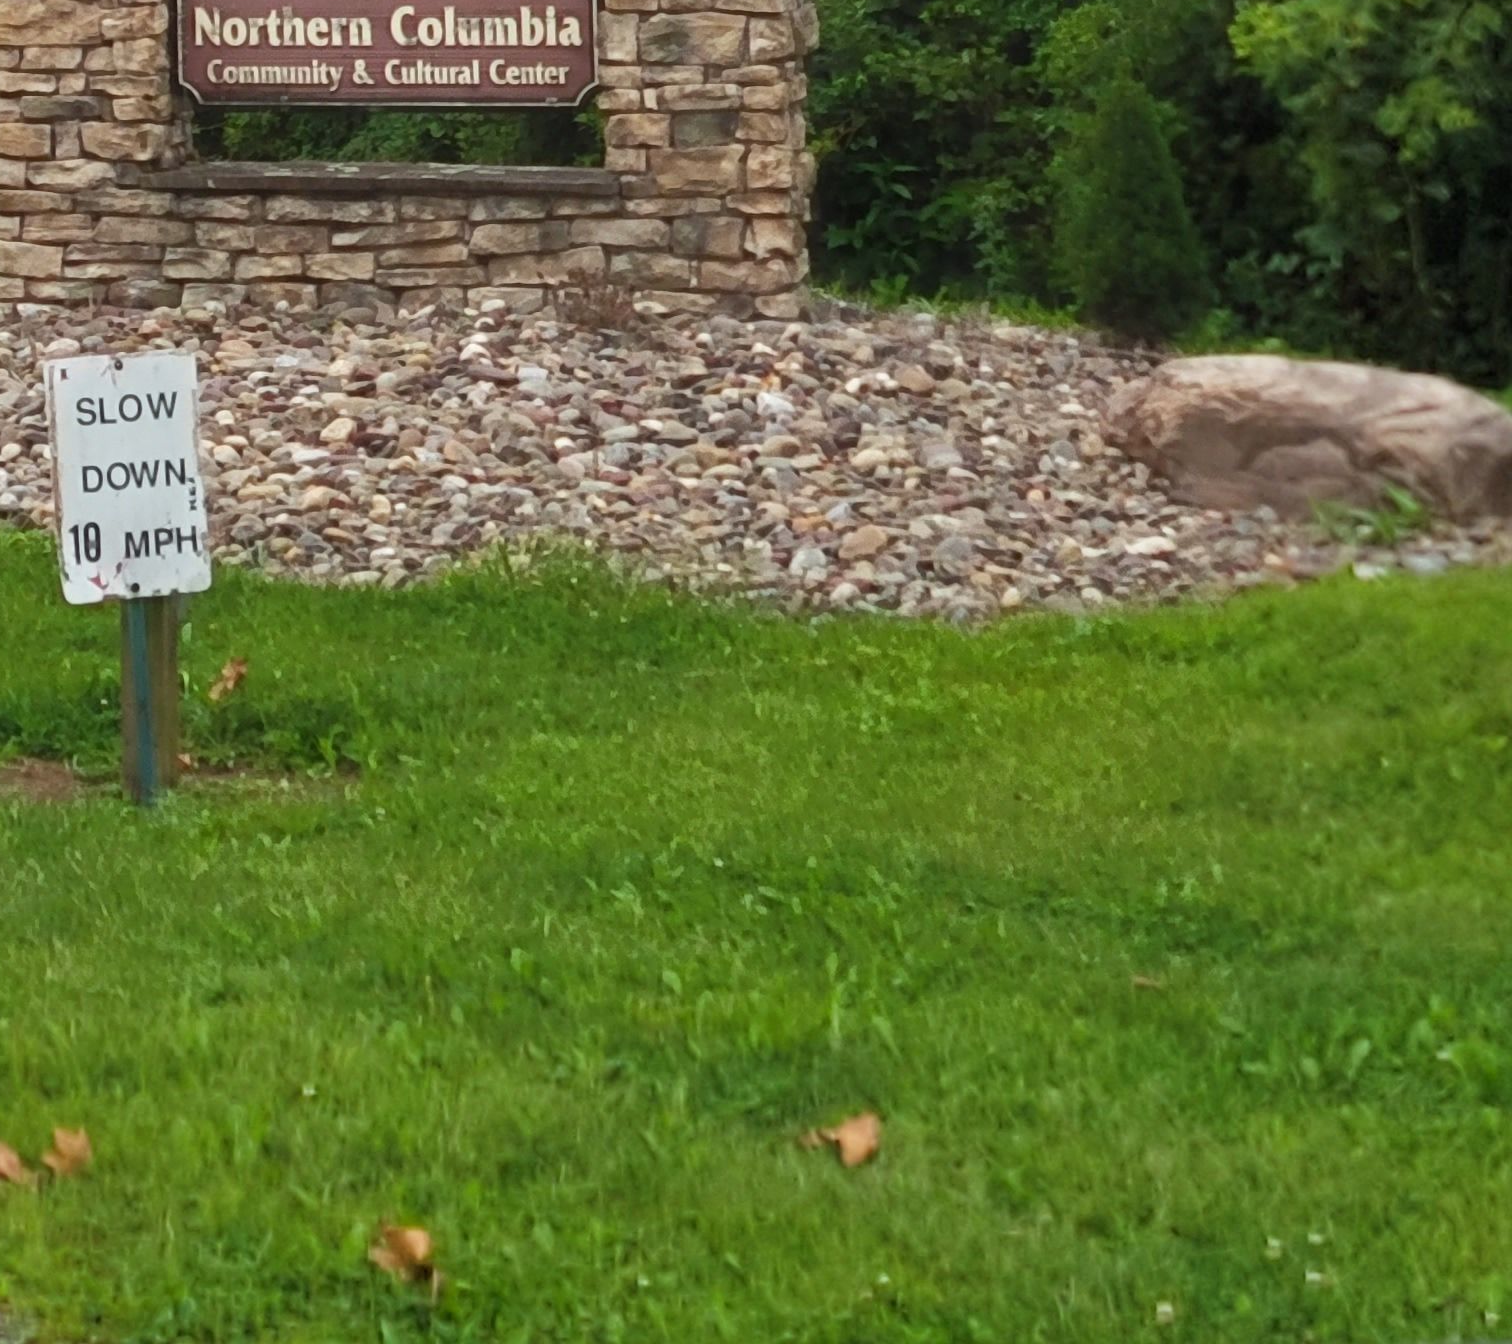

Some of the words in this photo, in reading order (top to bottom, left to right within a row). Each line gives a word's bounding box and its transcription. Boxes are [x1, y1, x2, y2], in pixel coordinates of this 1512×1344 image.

[194, 6, 373, 47] Northern
[390, 5, 583, 47] Columbia
[207, 59, 344, 92] Community
[352, 59, 375, 84] &
[384, 59, 481, 85] Cultural
[489, 59, 570, 85] Center
[76, 391, 178, 426] SLOW
[81, 458, 187, 493] DOWN
[69, 522, 101, 565] 10
[124, 525, 199, 559] MPH
